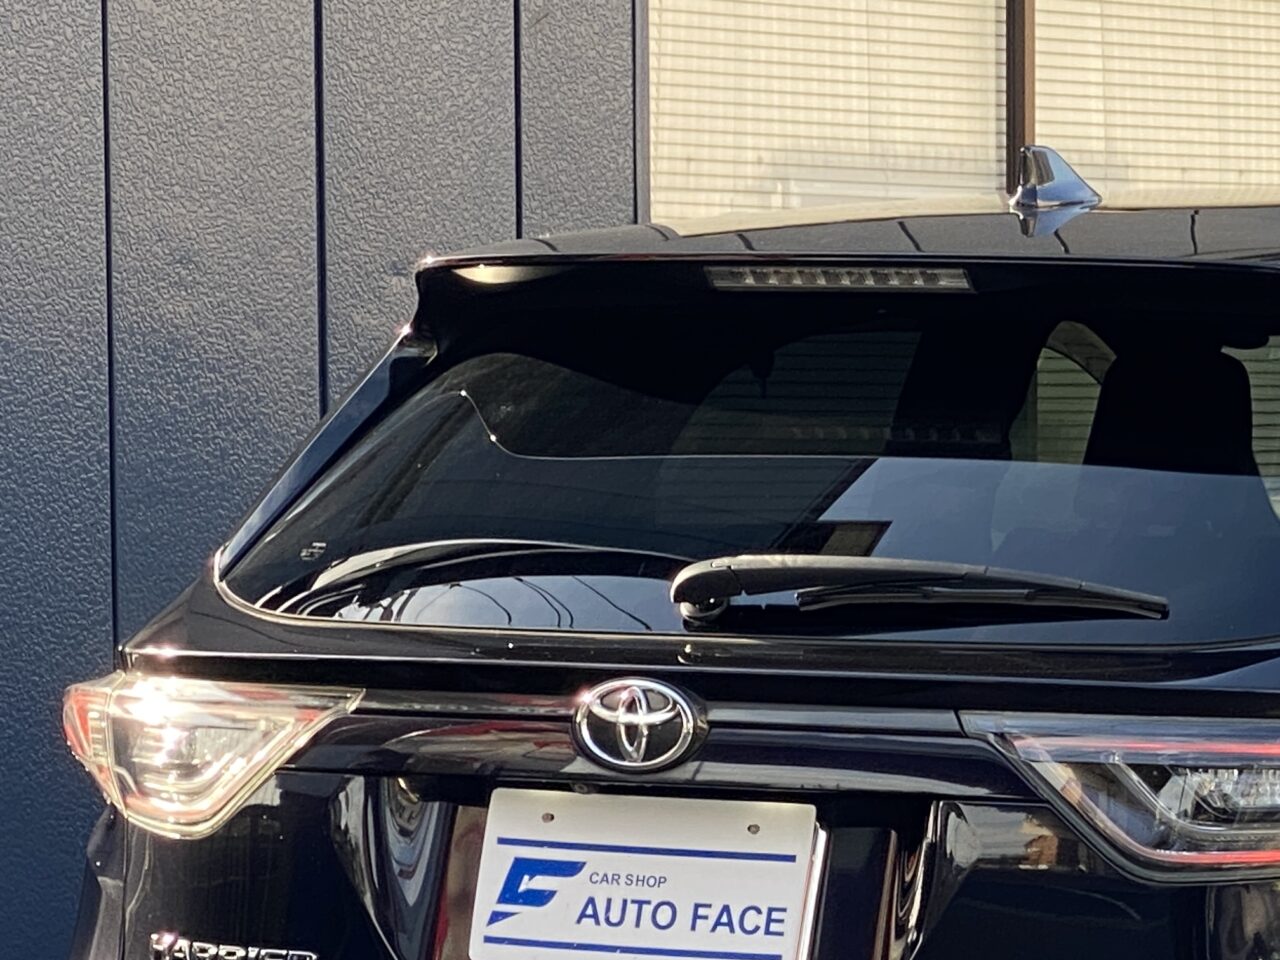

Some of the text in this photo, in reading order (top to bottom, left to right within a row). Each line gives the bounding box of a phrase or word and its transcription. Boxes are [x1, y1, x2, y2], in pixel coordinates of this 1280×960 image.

[589, 872, 667, 888] CAR SHOP
[576, 896, 787, 937] AUTO FACE
